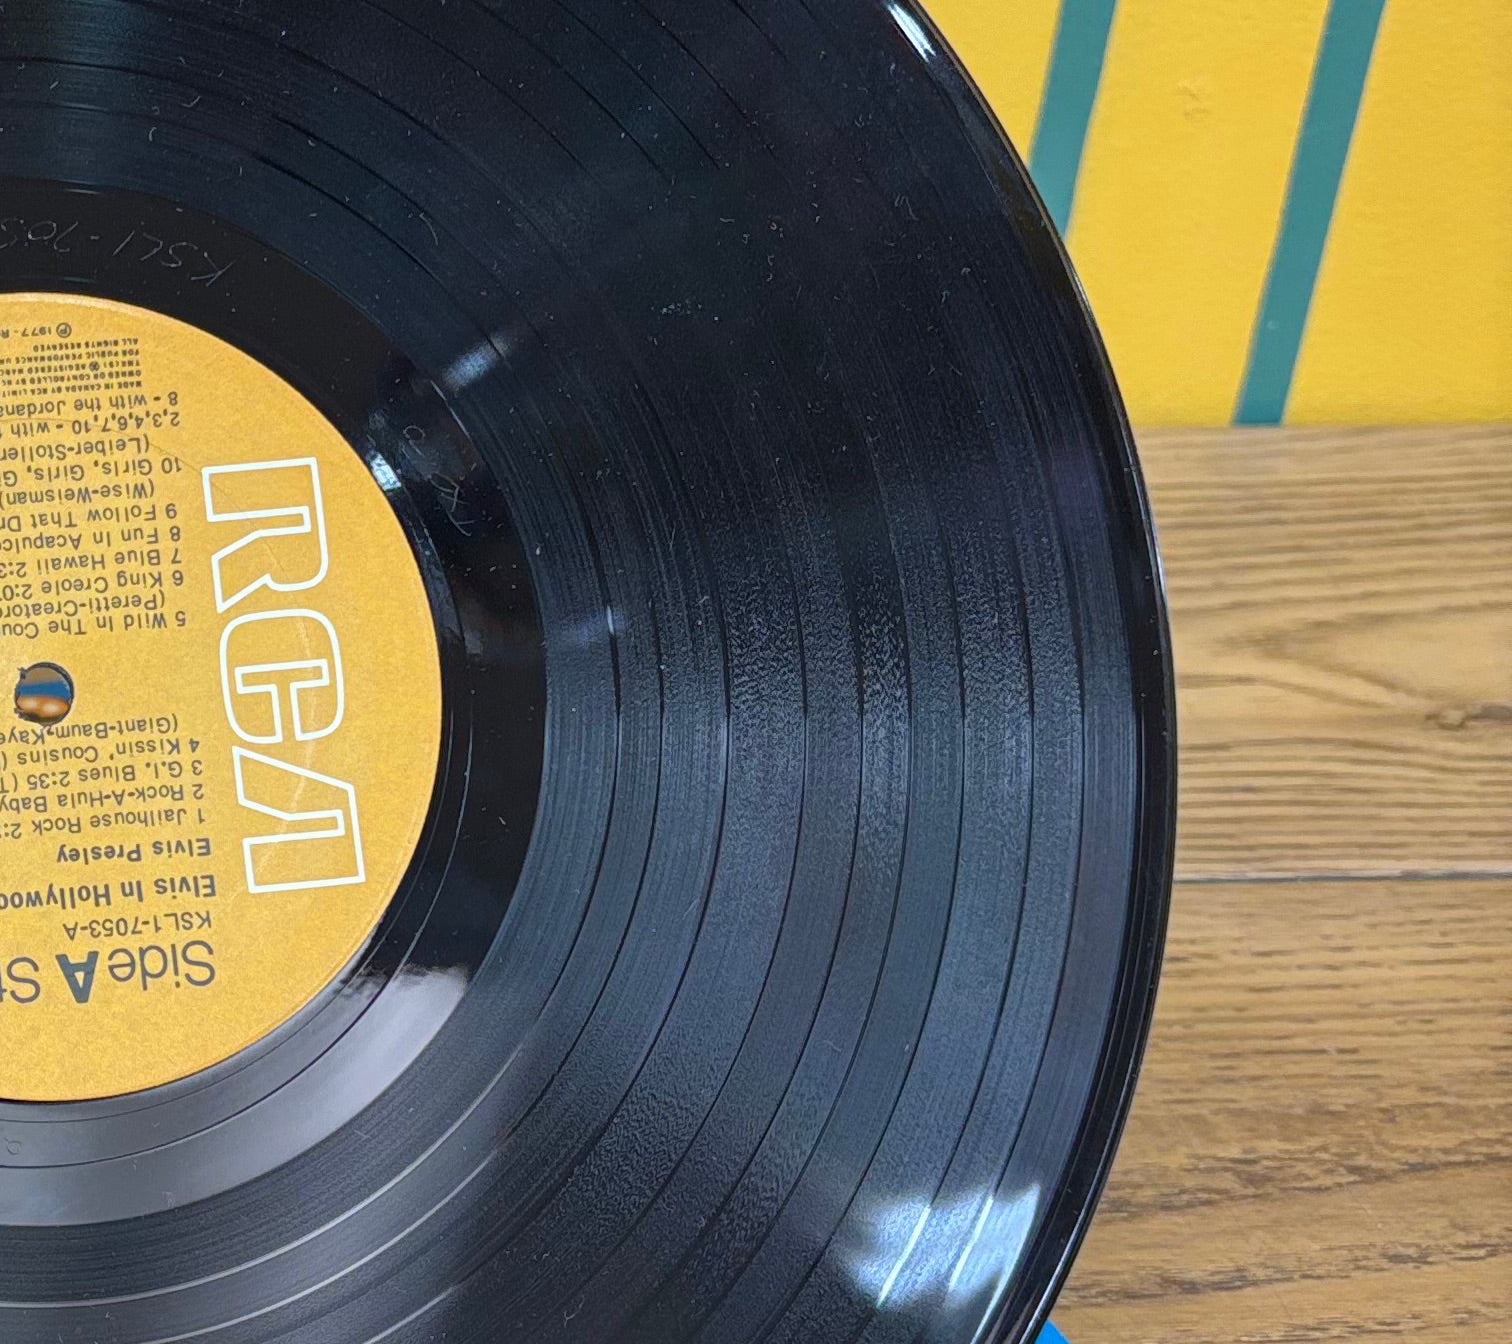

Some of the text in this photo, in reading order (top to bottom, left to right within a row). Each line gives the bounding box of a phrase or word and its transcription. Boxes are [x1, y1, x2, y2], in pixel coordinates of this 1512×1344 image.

[74, 397, 102, 412] the
[109, 394, 147, 410] with
[167, 391, 178, 406] 8
[10, 422, 50, 438] with
[72, 408, 180, 435] 2,3,4,6,7,10
[26, 464, 85, 483] Girls,
[93, 459, 152, 477] Girls,
[161, 457, 182, 474] 10
[30, 511, 78, 529] That
[87, 504, 156, 523] Follow
[165, 503, 177, 519] 9
[93, 531, 111, 547] In
[121, 527, 159, 544] Fun
[169, 525, 181, 542] 8
[37, 554, 105, 574] Hawaii
[114, 549, 161, 566] Blue
[171, 548, 182, 564] 7
[41, 576, 109, 596] Creole
[116, 570, 163, 589] King
[172, 570, 184, 587] 6
[48, 619, 87, 635] The
[96, 616, 113, 632] In
[124, 612, 167, 631] Wild
[175, 610, 186, 627] 5
[201, 455, 366, 895] RCA
[188, 738, 200, 753] 4
[17, 745, 99, 766] Cousins
[78, 764, 136, 782] Blues
[145, 761, 183, 779] G.I.
[191, 760, 203, 776] 3
[27, 771, 70, 790] 2:35
[56, 784, 184, 809] Rock-A-Hula
[192, 783, 204, 800] 2
[31, 816, 82, 836] Rock
[90, 808, 187, 828] Jailhouse
[56, 838, 211, 865] Elvis Presley
[120, 880, 144, 903] In
[153, 874, 216, 900] Elvis
[62, 910, 212, 941] KSL1-7053-A
[108, 940, 216, 991] Side
[55, 950, 99, 1004] A
